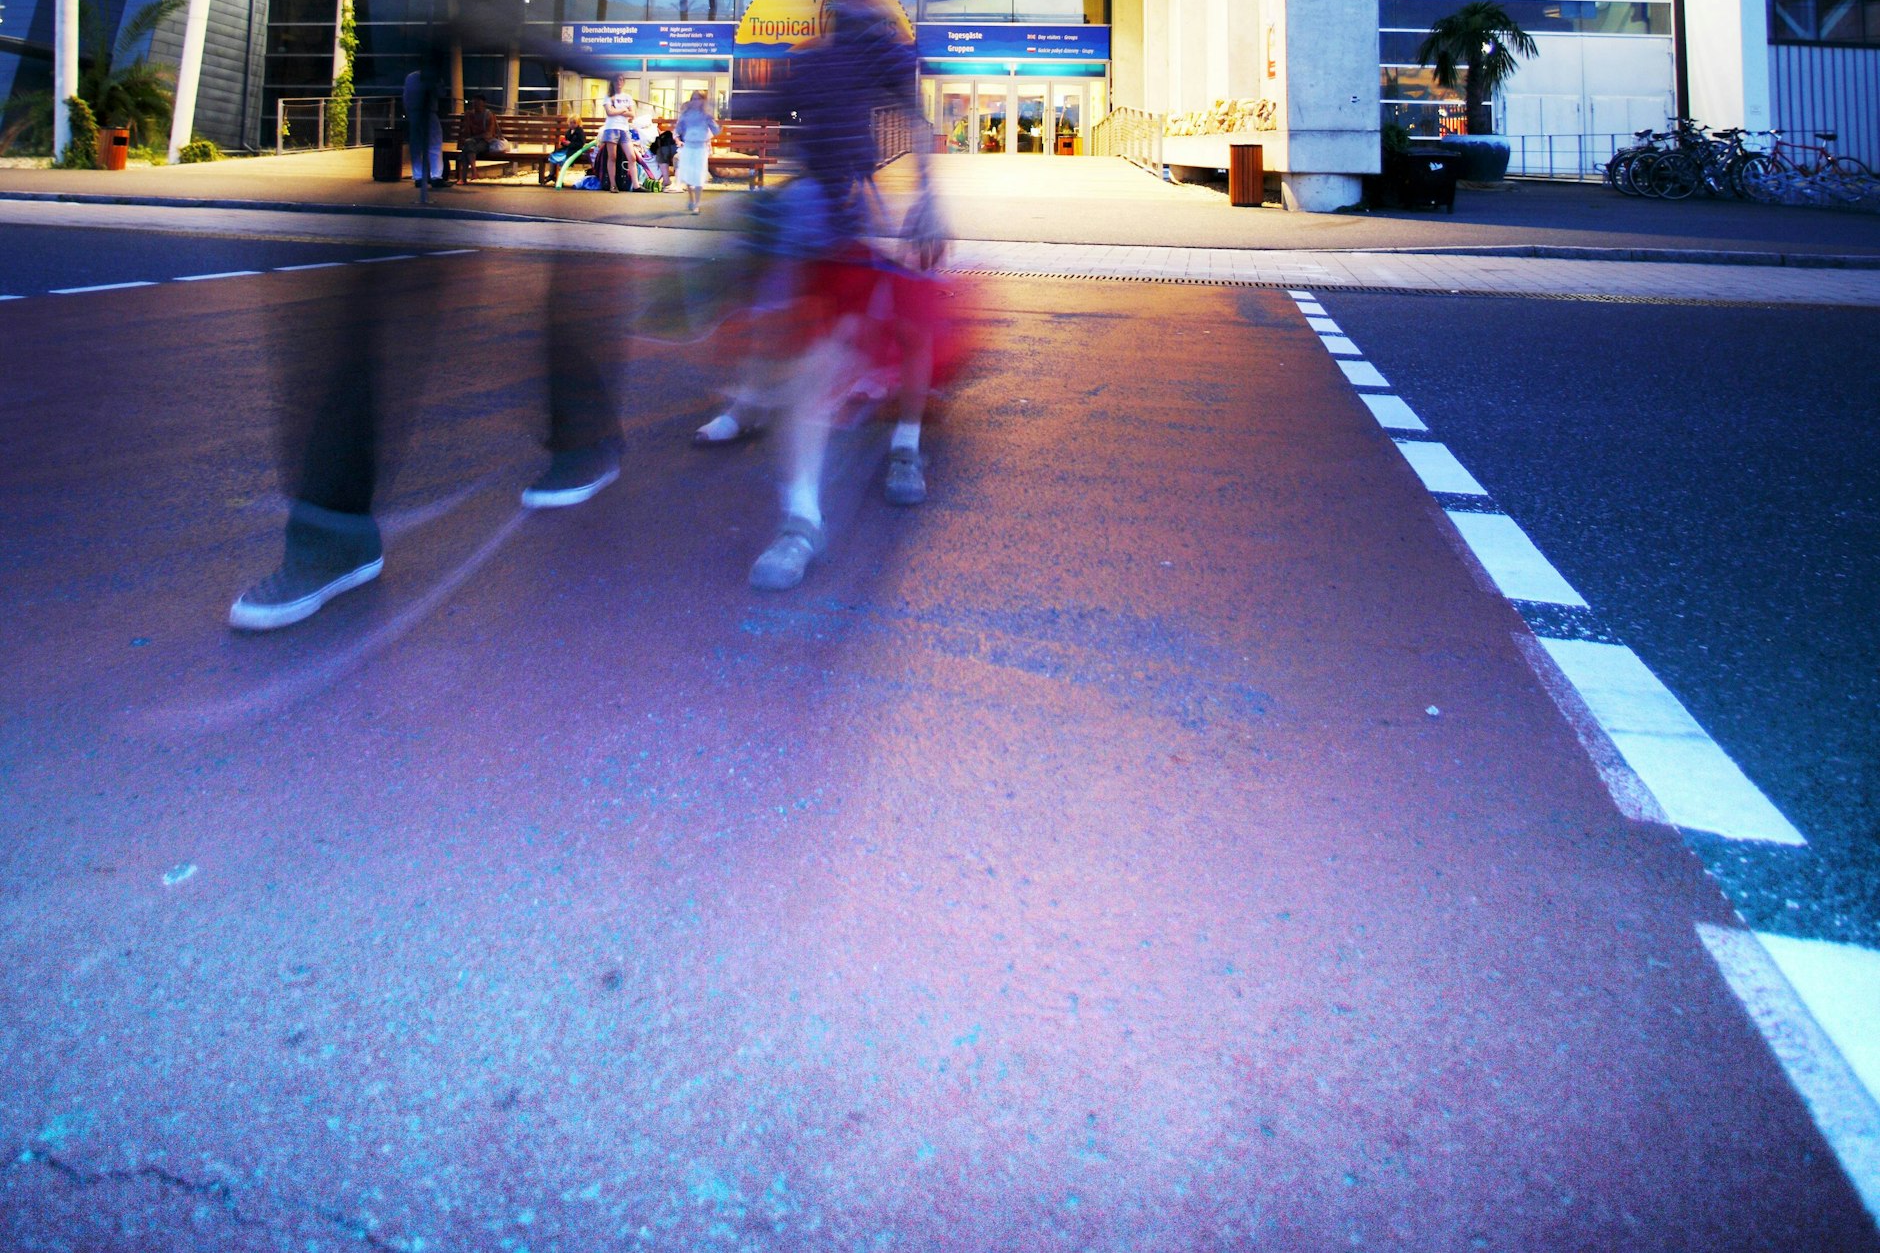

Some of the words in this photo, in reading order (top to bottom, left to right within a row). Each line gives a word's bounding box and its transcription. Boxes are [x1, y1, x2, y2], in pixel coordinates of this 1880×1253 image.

[581, 26, 638, 35] Übernachtungsgäste
[749, 17, 816, 40] Tropical
[948, 32, 983, 40] Tagesgäste
[947, 45, 975, 53] Gruppen
